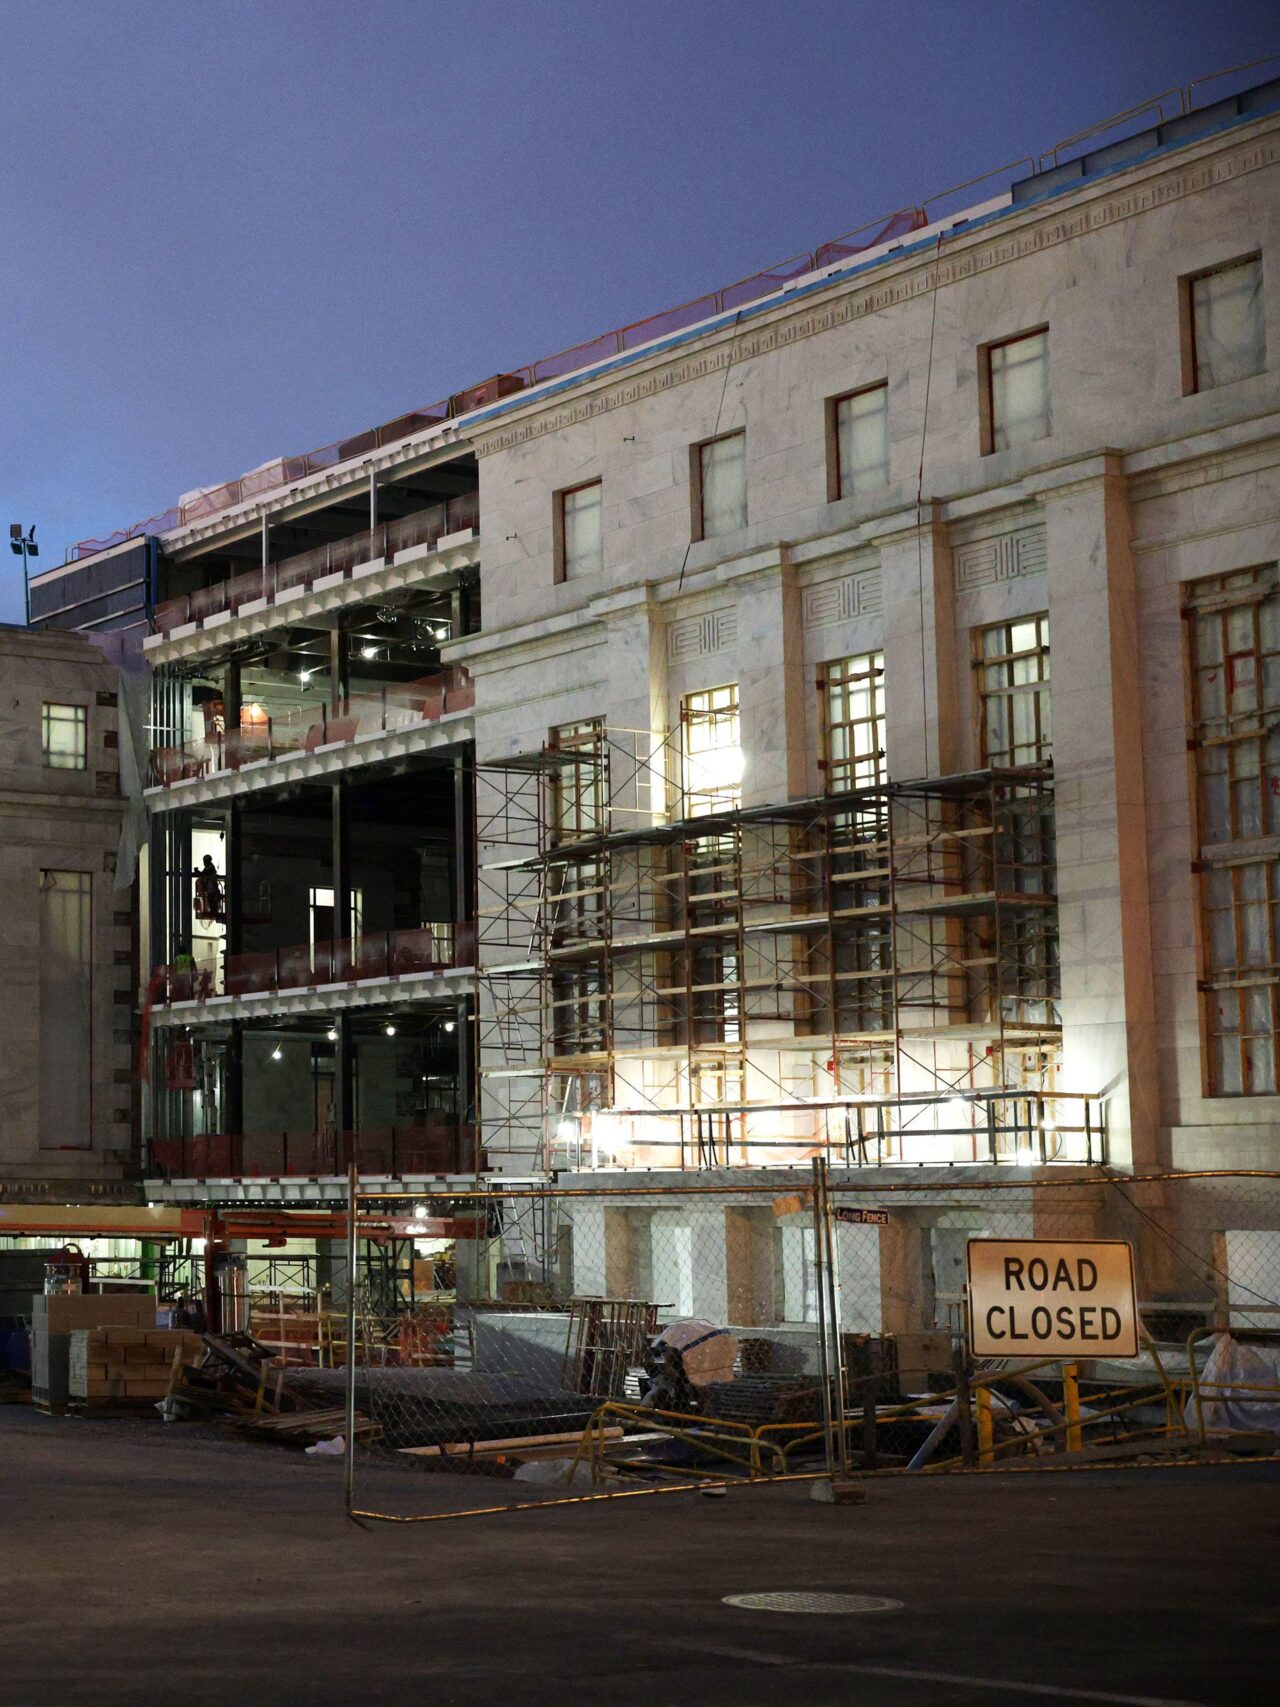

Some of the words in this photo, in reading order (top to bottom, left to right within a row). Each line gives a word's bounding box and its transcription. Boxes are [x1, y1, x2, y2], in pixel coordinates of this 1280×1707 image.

[836, 1208, 861, 1223] LONG
[862, 1210, 887, 1224] FENCE
[1004, 1257, 1097, 1291] ROAD
[986, 1306, 1121, 1340] CLOSED
